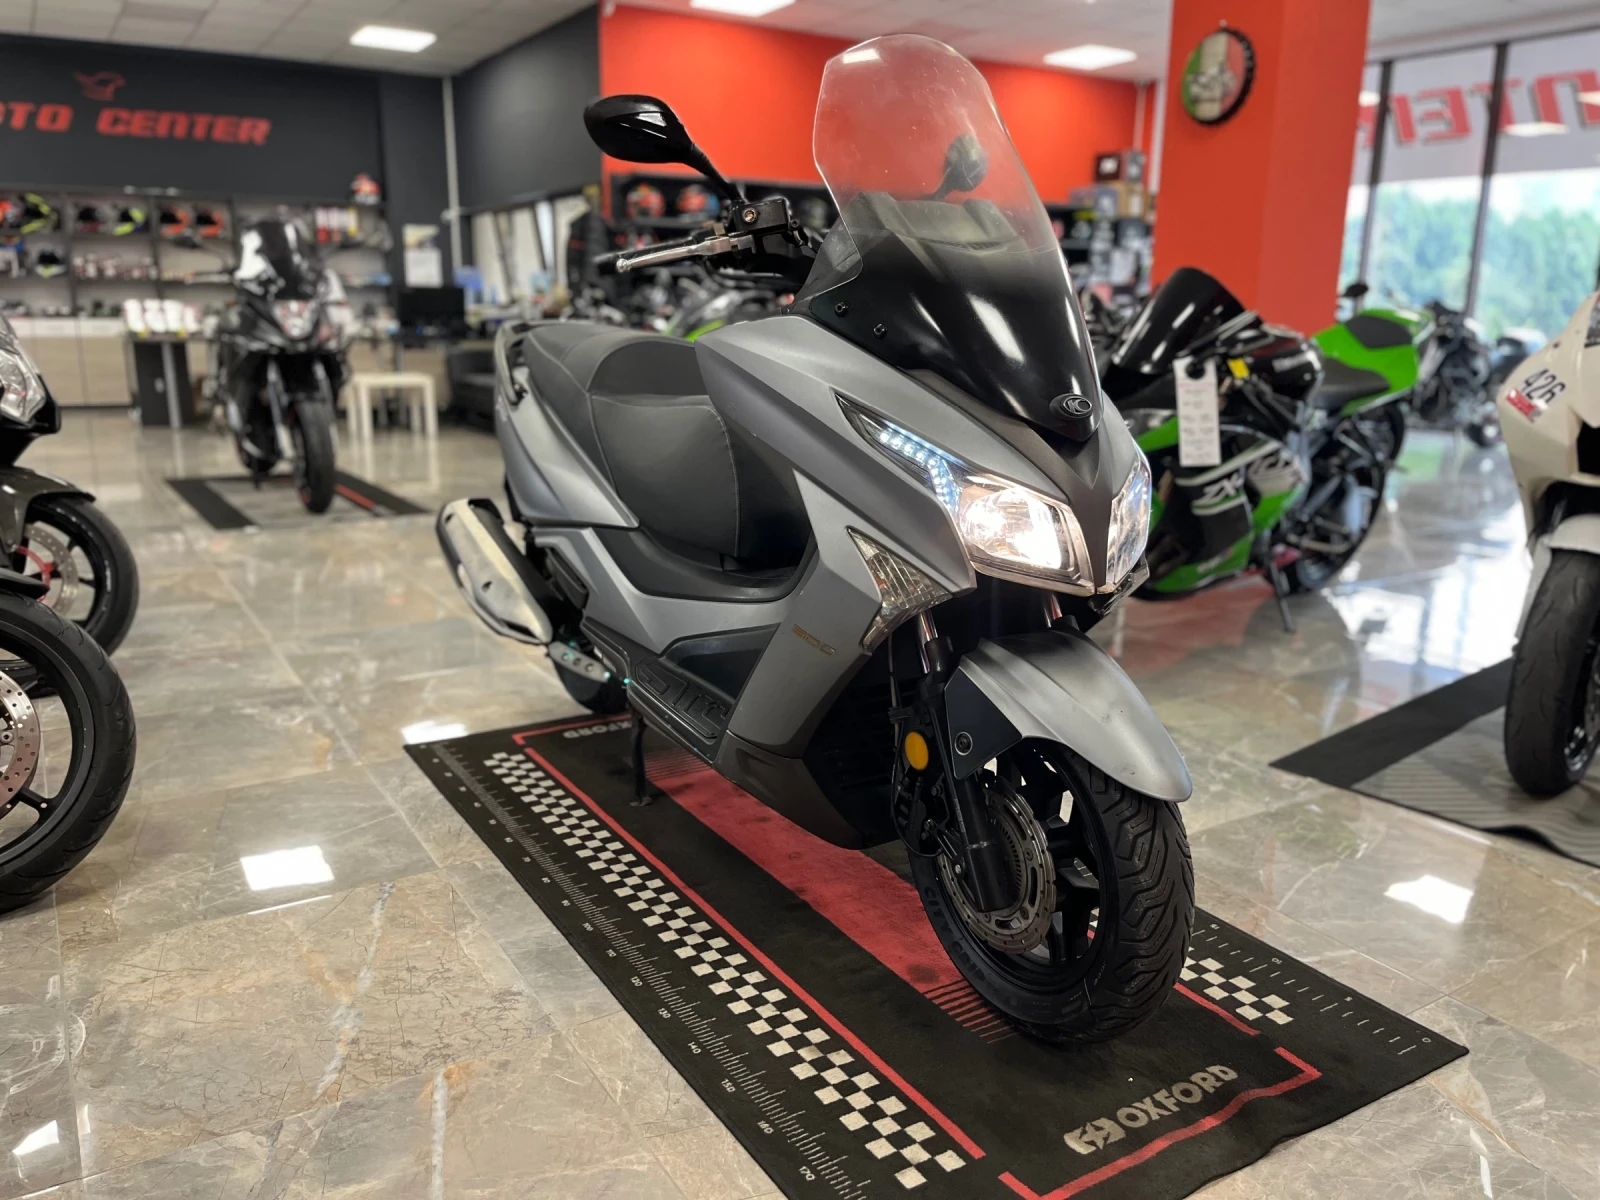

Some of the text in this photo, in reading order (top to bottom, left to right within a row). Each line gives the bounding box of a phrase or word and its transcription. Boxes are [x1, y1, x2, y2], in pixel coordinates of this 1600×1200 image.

[0, 101, 271, 145] TO CENTER
[1522, 367, 1566, 403] 426
[563, 720, 633, 738] XFORD
[687, 1041, 701, 1054] 140
[720, 1078, 736, 1093] 150
[1116, 1064, 1238, 1128] OXFORD
[757, 1120, 774, 1134] 160
[799, 1165, 816, 1181] 170
